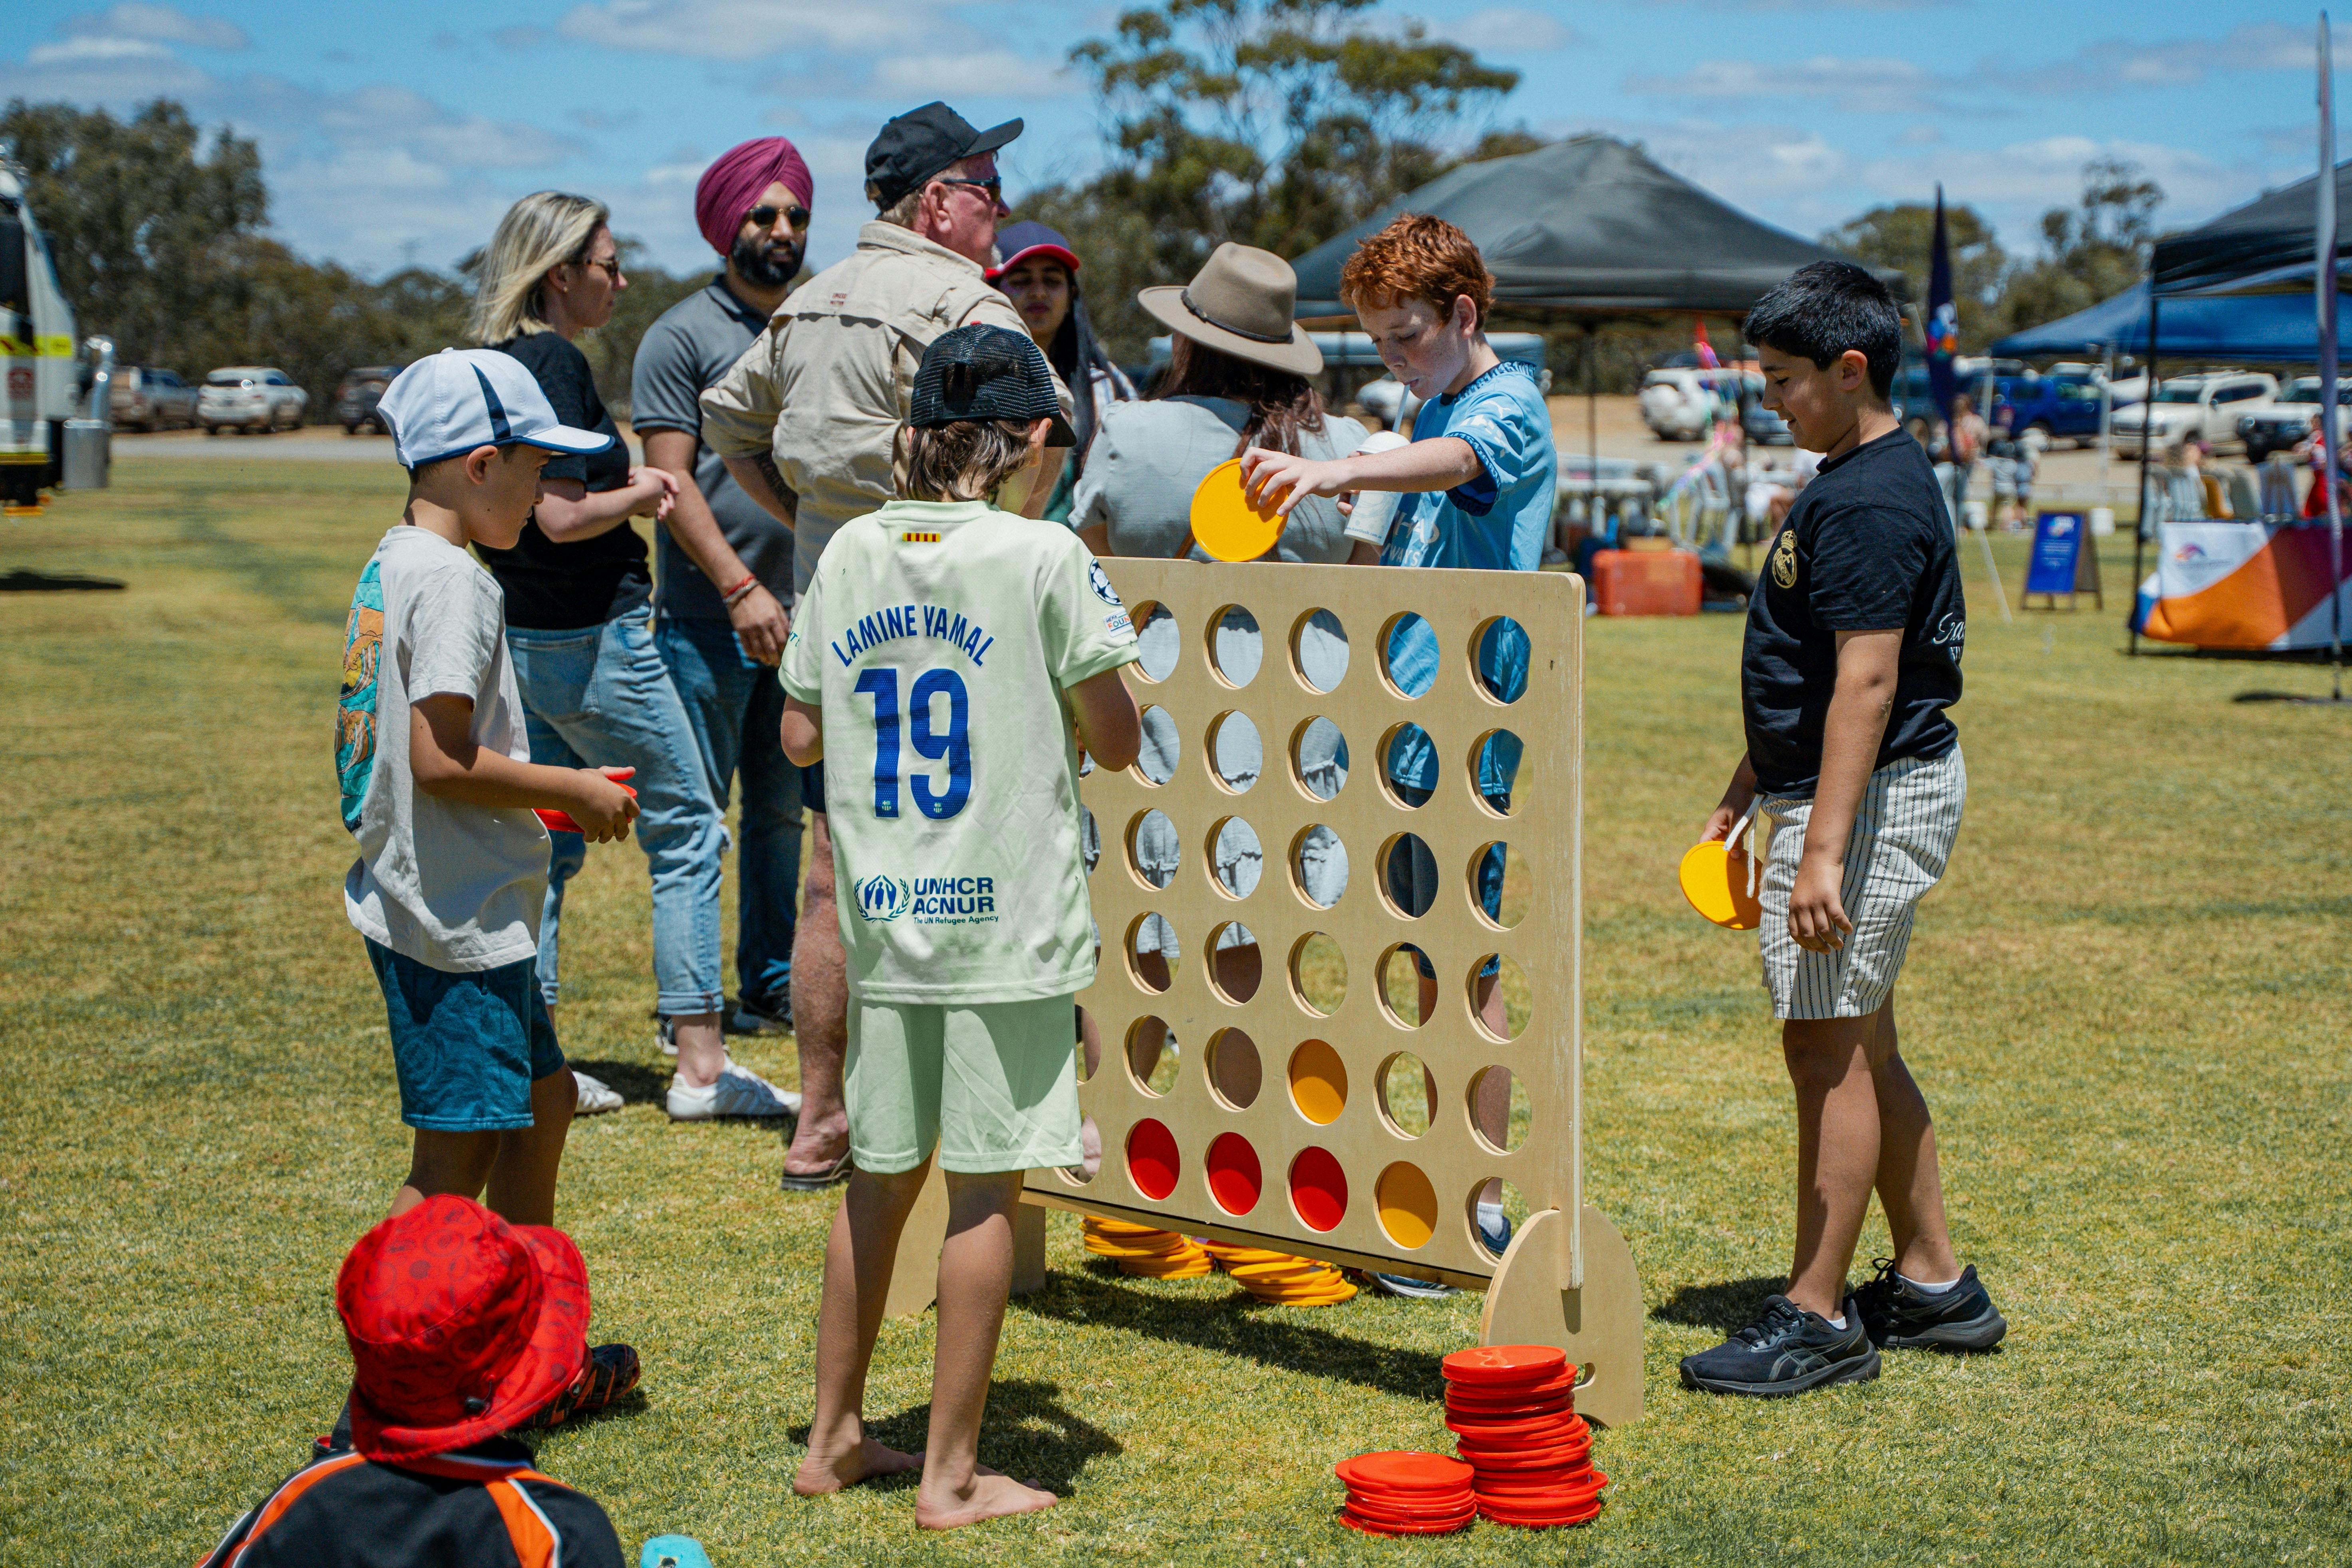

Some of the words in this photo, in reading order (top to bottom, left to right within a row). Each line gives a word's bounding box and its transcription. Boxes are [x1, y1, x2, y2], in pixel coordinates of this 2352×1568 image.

[1393, 512, 1440, 544] HAD
[1108, 616, 1130, 629] FOUN
[831, 605, 917, 668] LAMINE
[923, 605, 995, 668] YAMAL
[854, 668, 971, 819] 19
[914, 877, 994, 895] UNHCR
[912, 896, 995, 914] ACNUR
[935, 917, 966, 925] Refugee
[968, 916, 999, 924] Agency
